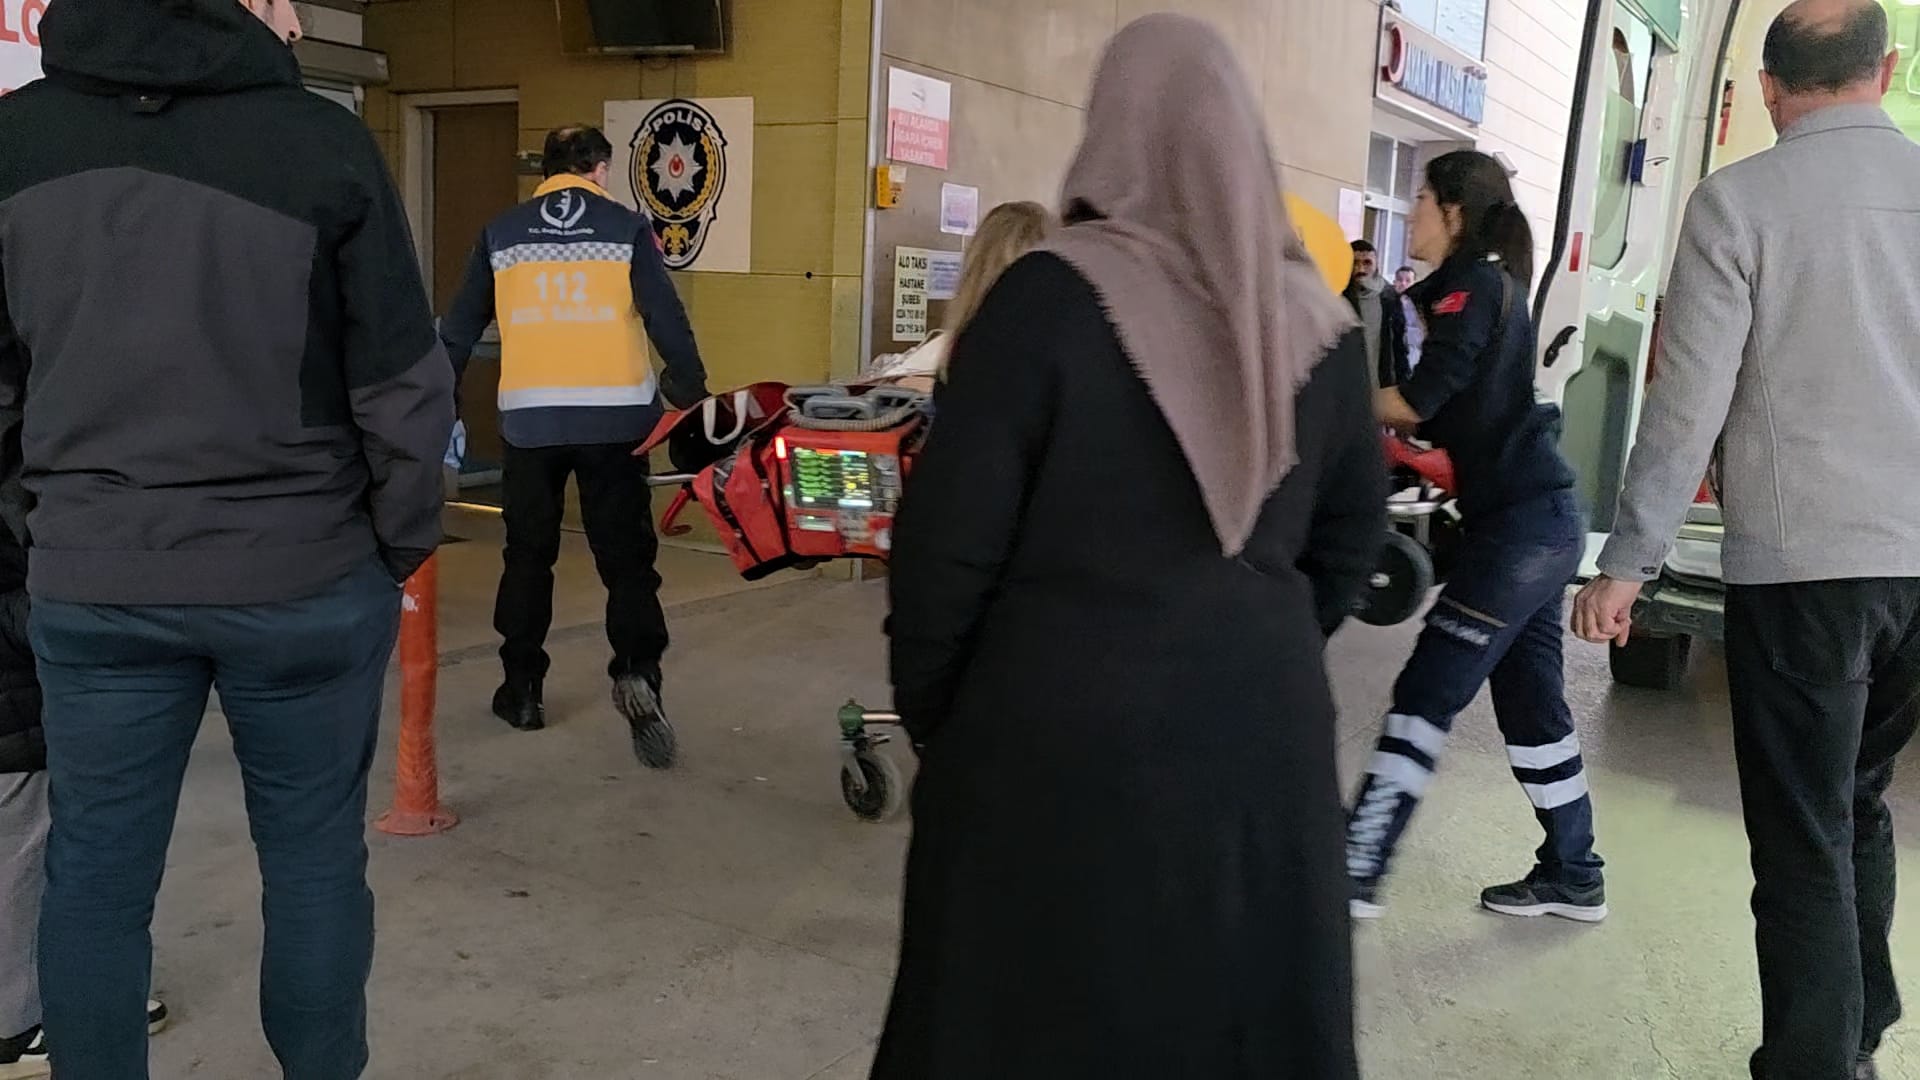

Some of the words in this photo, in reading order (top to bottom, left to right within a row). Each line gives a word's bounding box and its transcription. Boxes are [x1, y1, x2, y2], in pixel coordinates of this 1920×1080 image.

[652, 110, 703, 132] POLİS
[899, 255, 911, 269] ALO
[534, 271, 588, 303] 112
[900, 278, 925, 290] HASTANE
